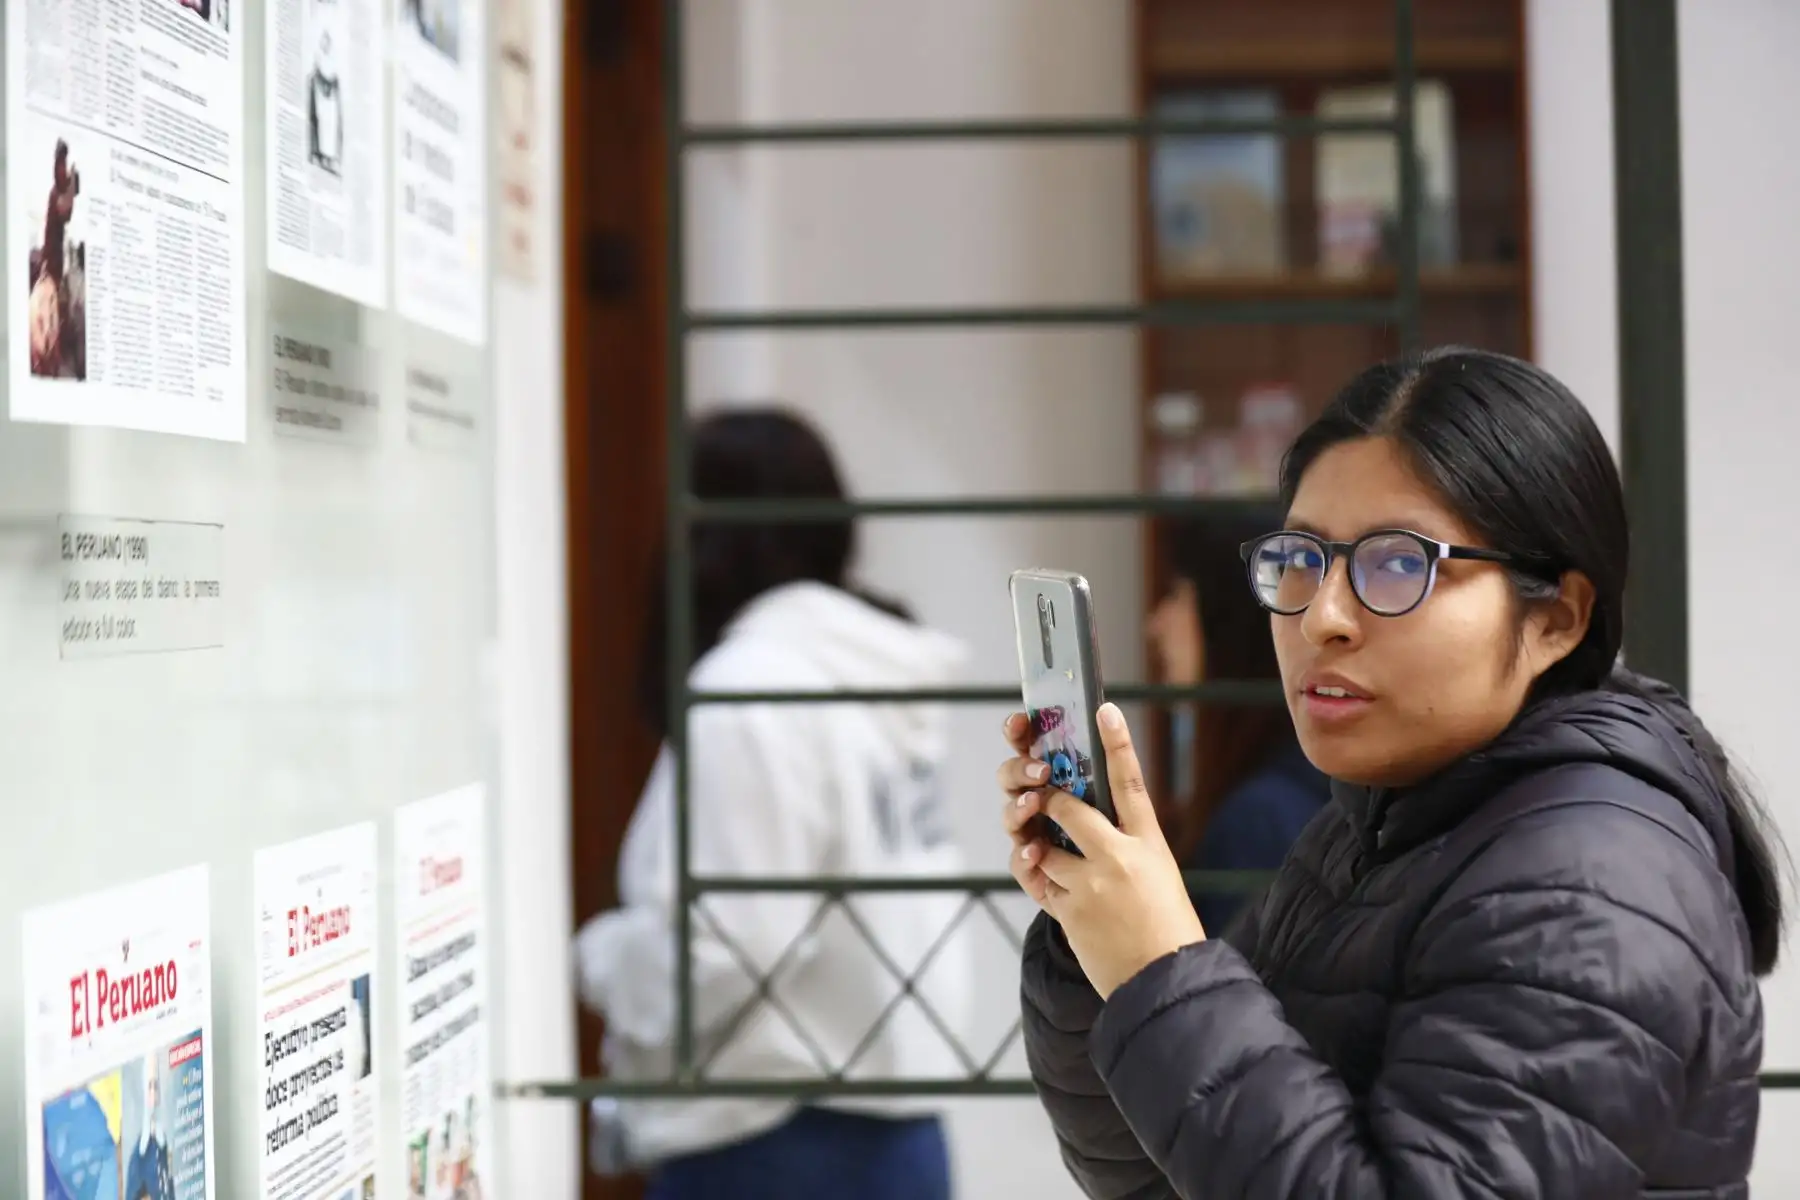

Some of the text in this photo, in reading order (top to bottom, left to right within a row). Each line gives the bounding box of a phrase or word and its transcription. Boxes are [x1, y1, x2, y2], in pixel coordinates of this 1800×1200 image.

[62, 532, 74, 560] EL
[76, 533, 122, 560] PERUANO
[62, 577, 81, 602] Una
[85, 579, 111, 600] nueva
[115, 577, 138, 604] etapa
[141, 574, 153, 599] del
[287, 906, 300, 957] El
[303, 904, 351, 952] Peruano
[70, 958, 177, 1039] El Peruano
[264, 1020, 308, 1073] Ejecutivo
[309, 1005, 347, 1053] presenta
[265, 1076, 288, 1111] doce
[289, 1052, 332, 1107] proyectos
[266, 1116, 304, 1157] reforma
